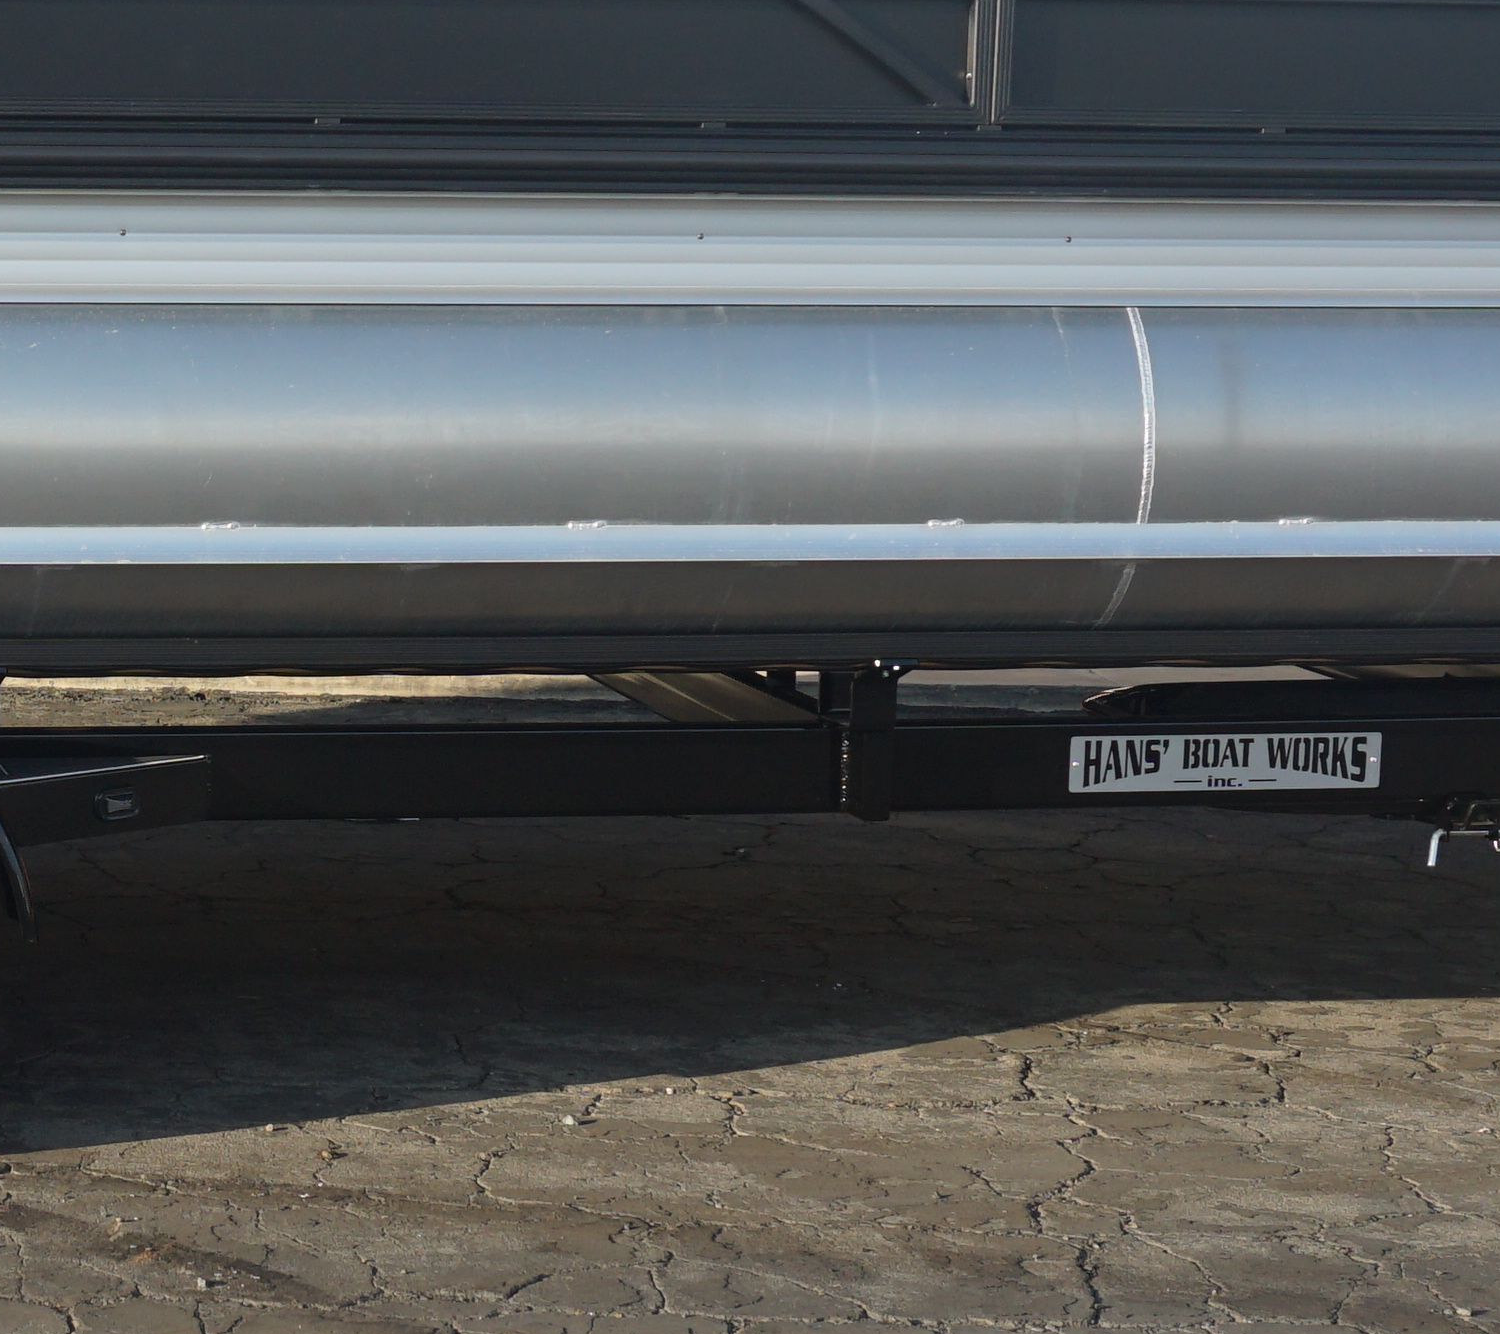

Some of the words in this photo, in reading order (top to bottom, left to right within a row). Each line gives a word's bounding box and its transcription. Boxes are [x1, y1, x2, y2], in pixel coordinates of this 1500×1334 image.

[1082, 739, 1170, 788] HANS'
[1182, 738, 1255, 770] BOAT
[1267, 736, 1368, 783] WORKS
[1207, 775, 1243, 788] inc.
